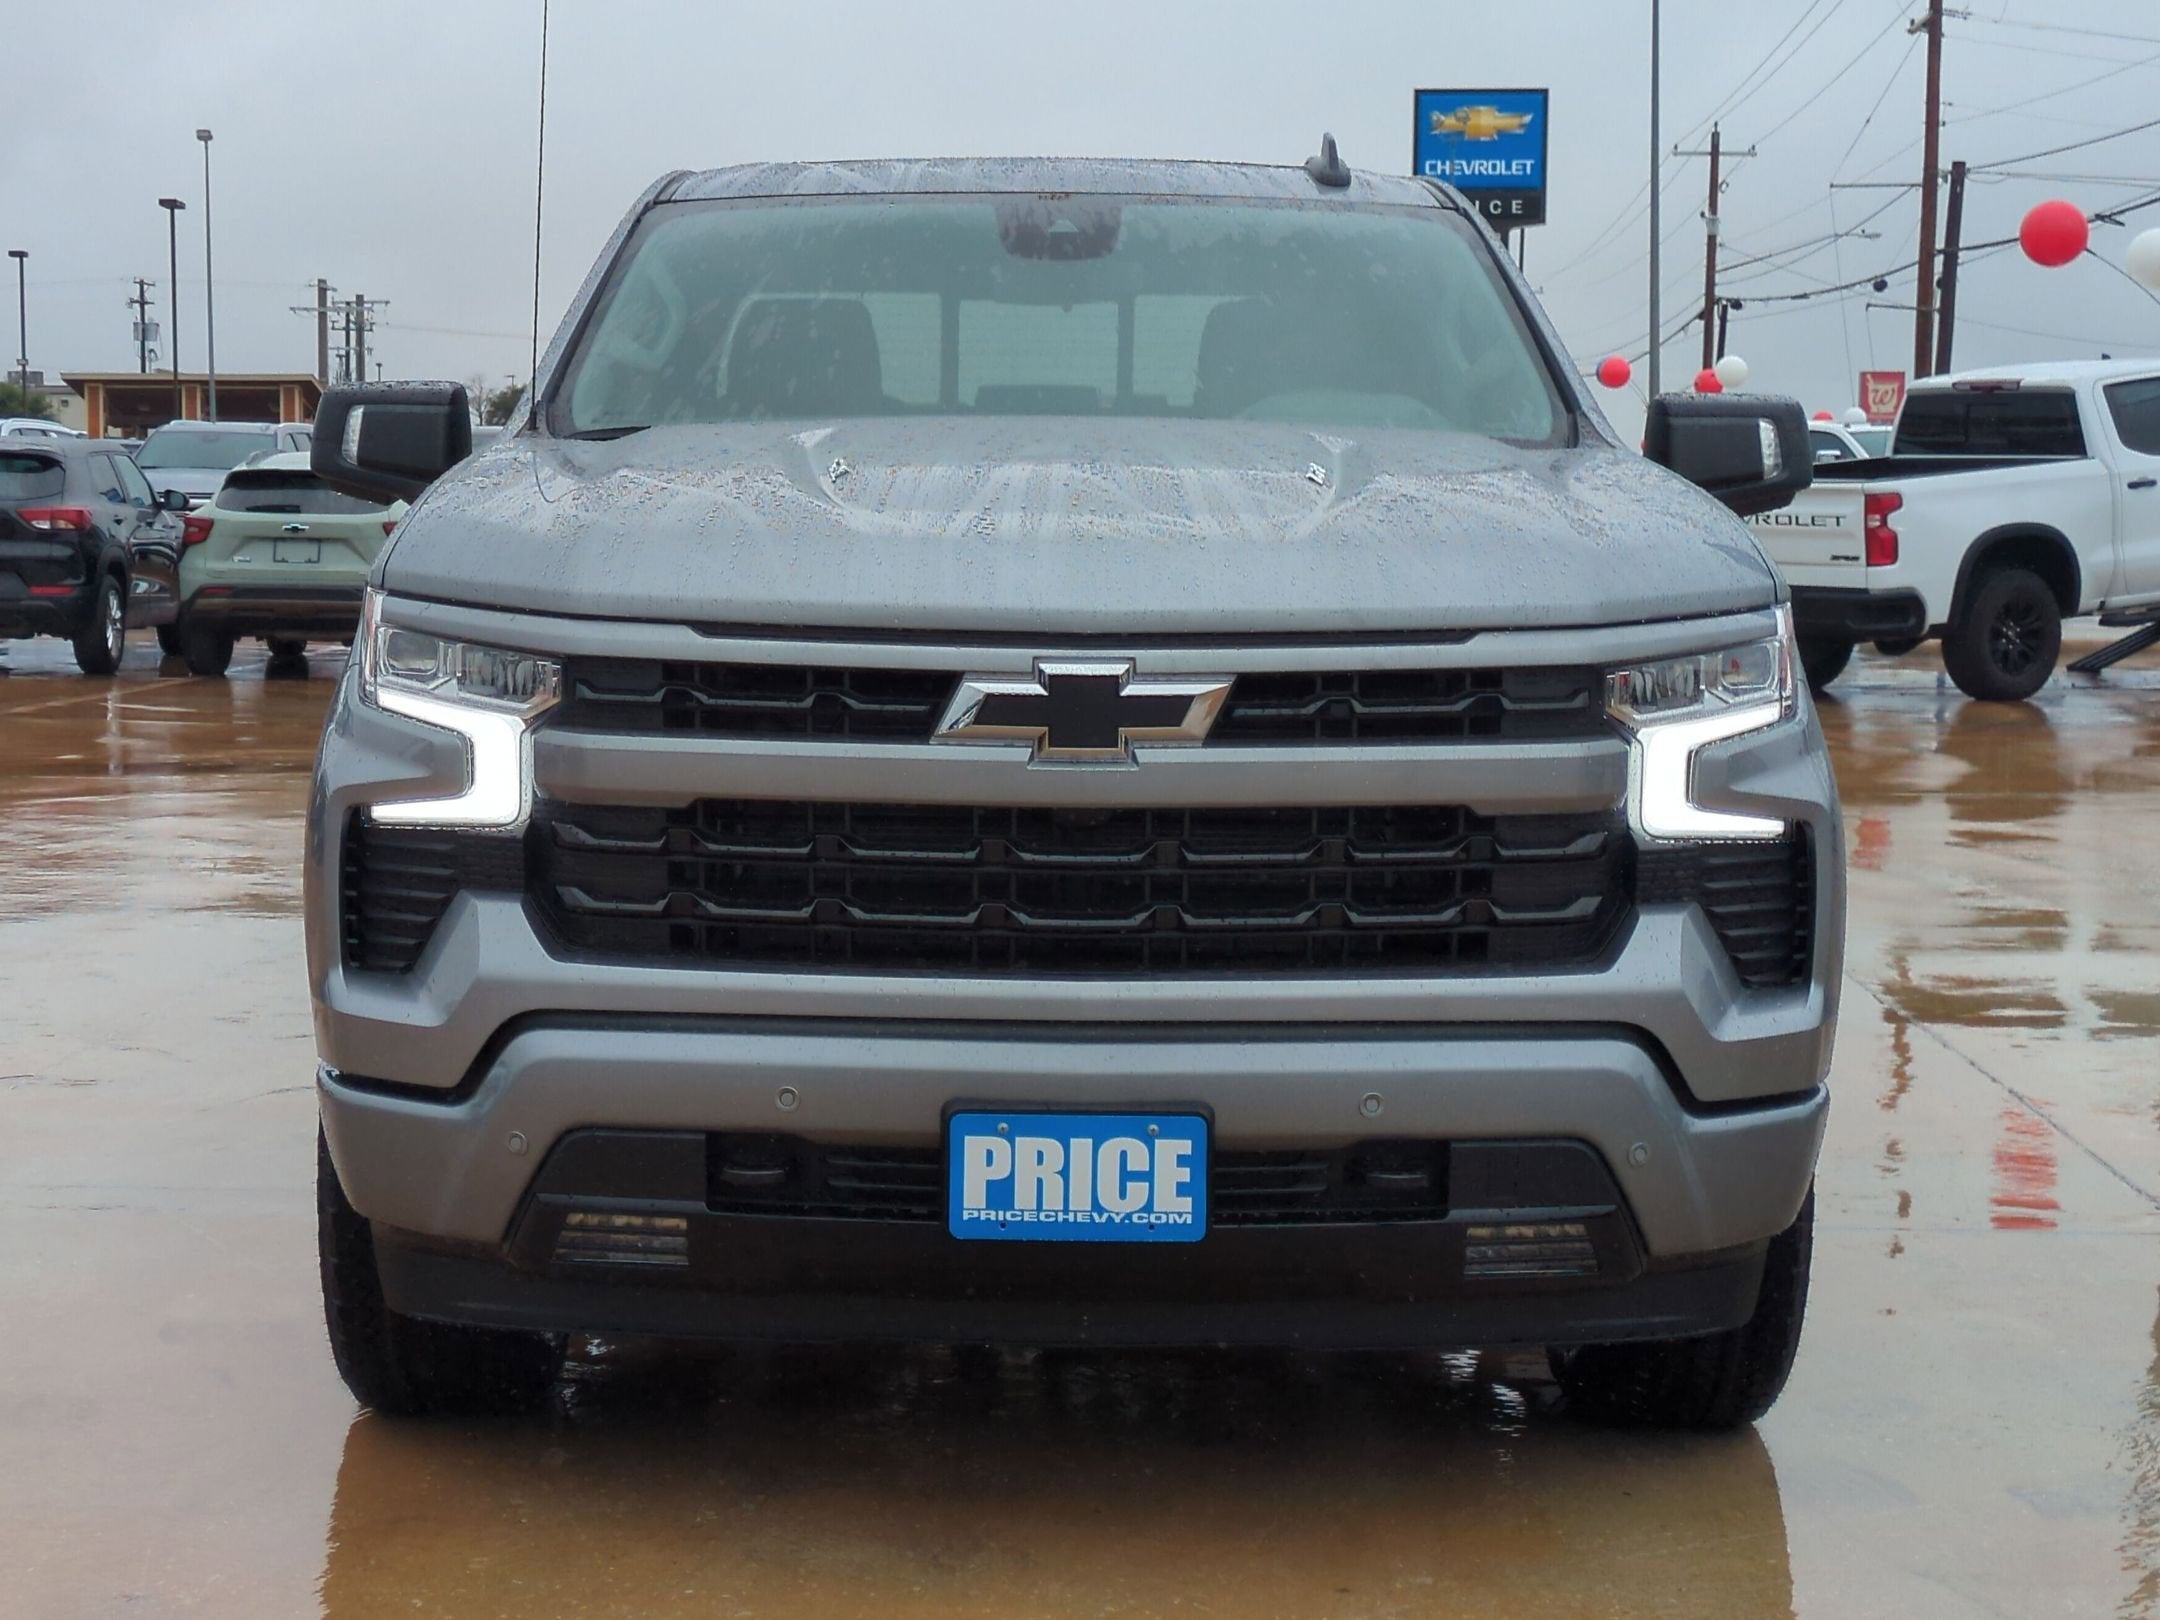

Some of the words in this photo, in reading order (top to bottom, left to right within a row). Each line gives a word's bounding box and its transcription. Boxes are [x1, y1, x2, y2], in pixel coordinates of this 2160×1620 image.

[1425, 159, 1535, 176] CHEVROLET
[963, 1135, 1192, 1213] PRICE
[963, 1209, 1192, 1224] PRICECHEVY.COM
